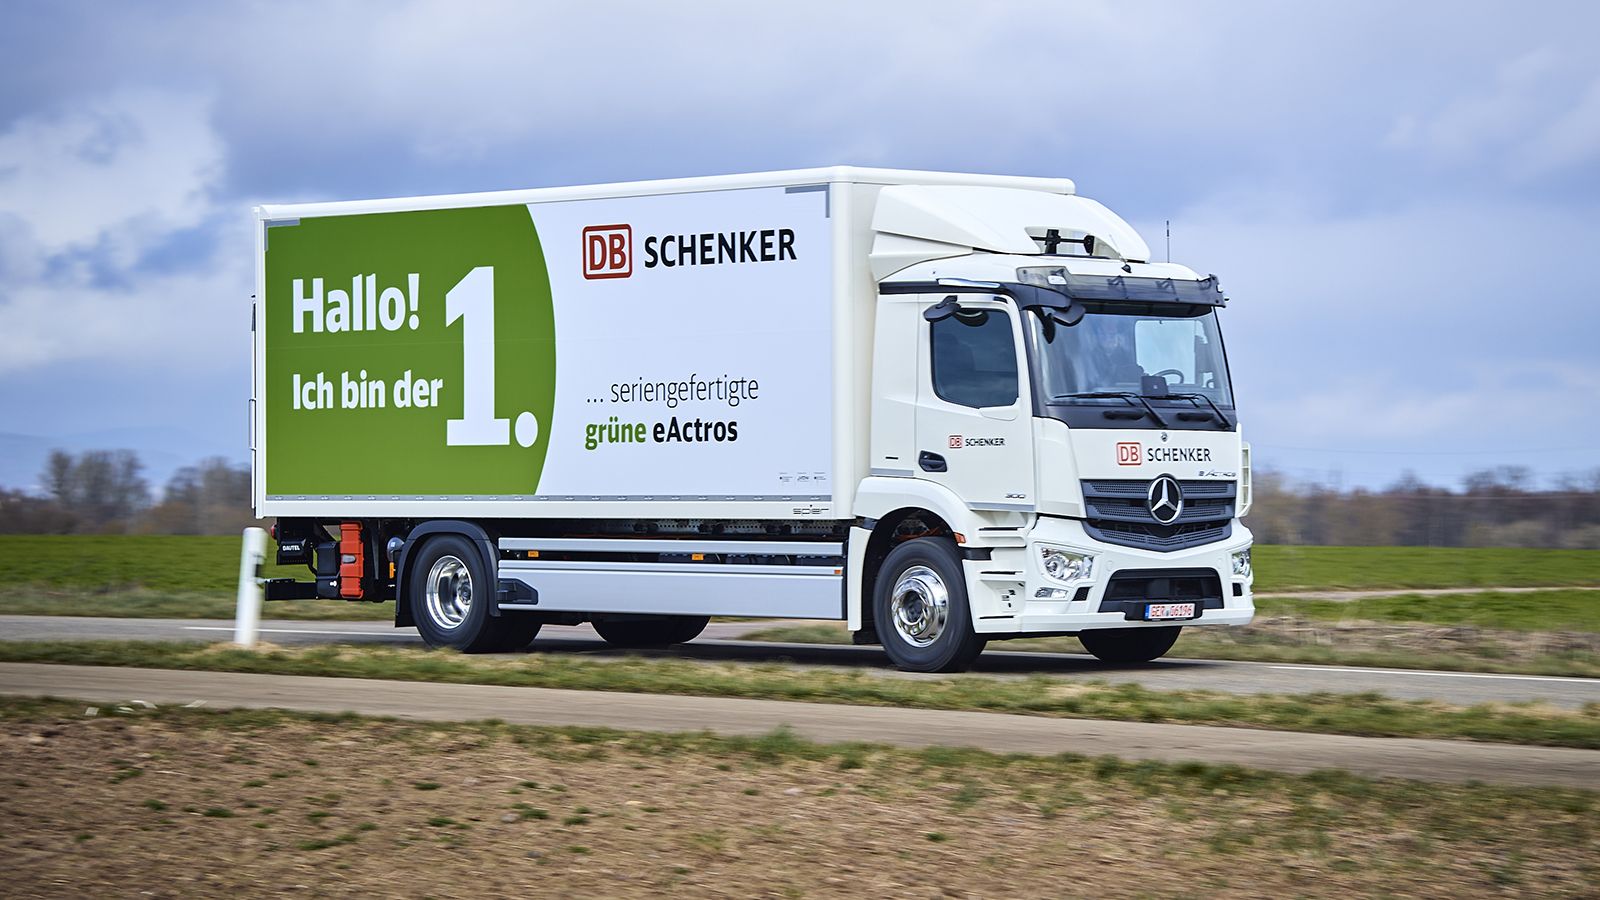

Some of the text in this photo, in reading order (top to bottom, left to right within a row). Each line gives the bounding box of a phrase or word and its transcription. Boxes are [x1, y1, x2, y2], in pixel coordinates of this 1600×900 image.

[588, 228, 797, 271] DB SCHENKER
[292, 273, 420, 333] Hallo!
[445, 265, 539, 448] 1.
[292, 369, 444, 410] Ich bin der
[610, 373, 759, 409] seriengefertigte
[585, 415, 738, 451] grüne eActros
[965, 437, 1006, 448] SCHENKER
[1120, 446, 1212, 462] DB SCHENKER
[793, 504, 829, 515] spier
